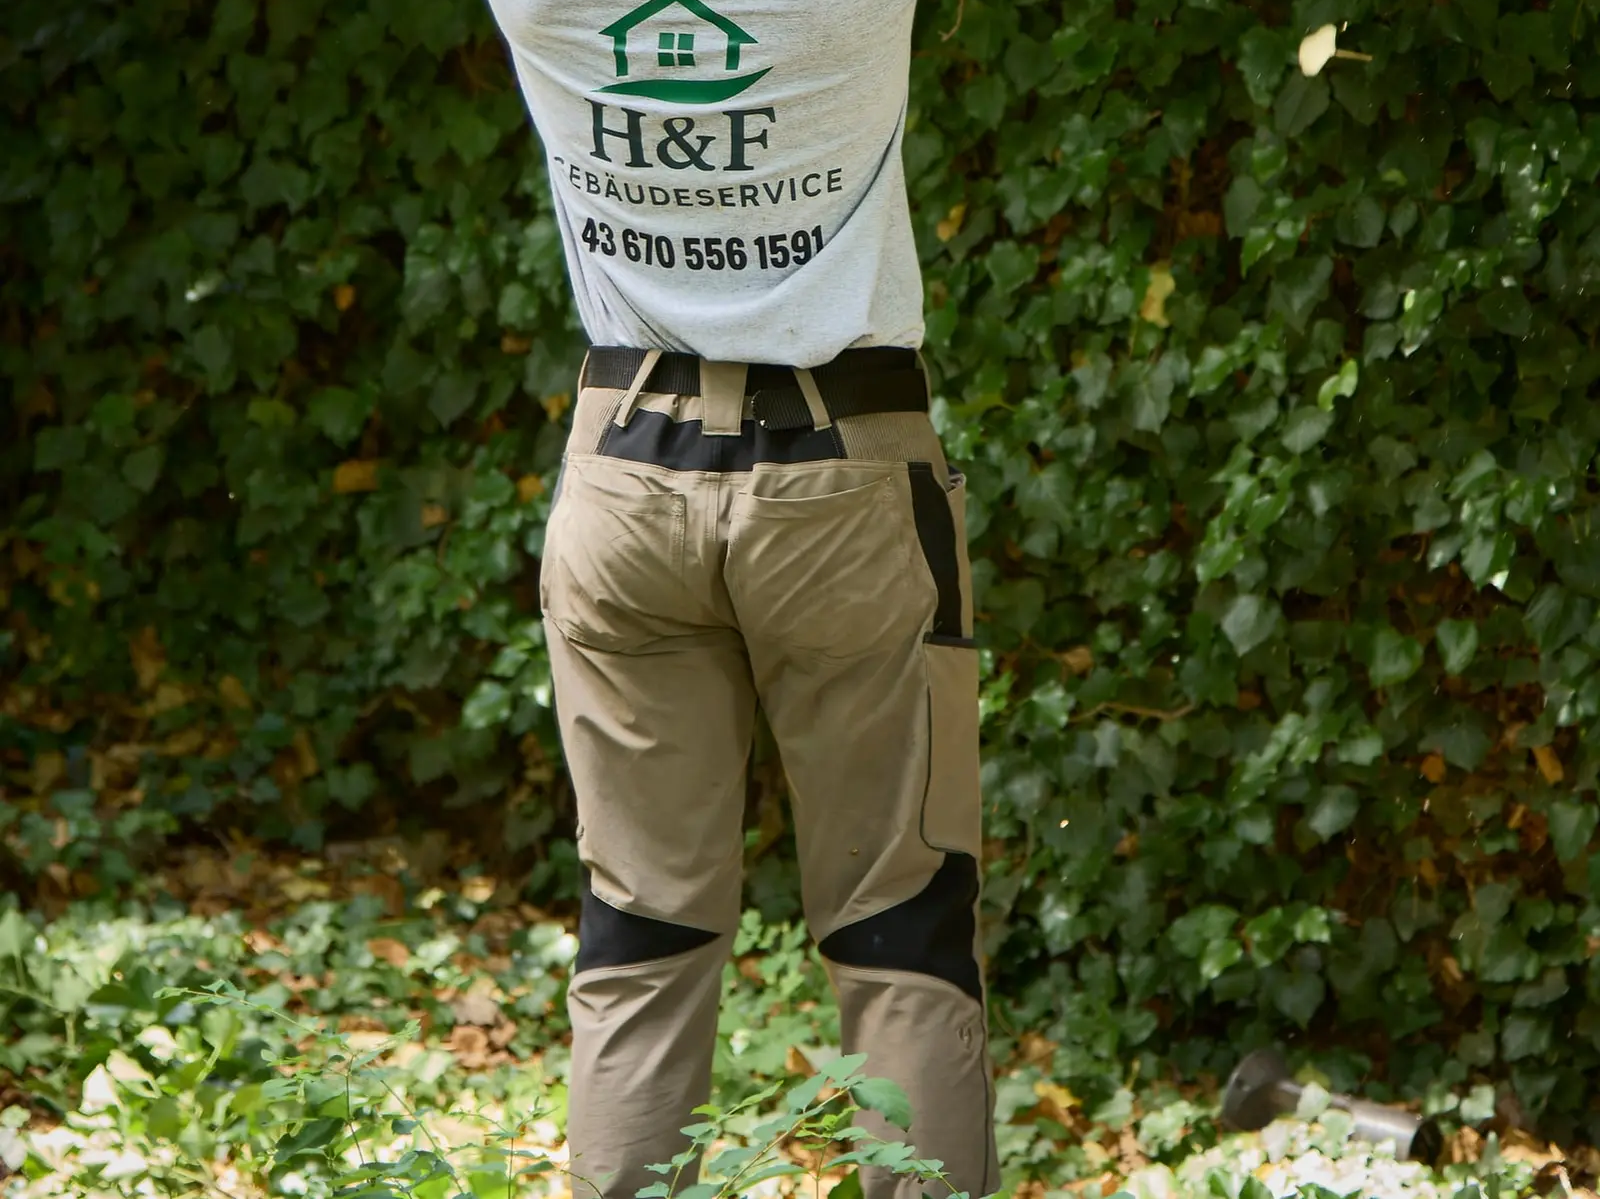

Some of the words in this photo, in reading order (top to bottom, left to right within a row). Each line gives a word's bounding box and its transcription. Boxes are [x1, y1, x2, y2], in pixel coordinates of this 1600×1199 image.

[584, 97, 777, 172] H&F
[581, 216, 617, 258] 43
[621, 224, 676, 270] 670
[682, 236, 748, 271] 556
[753, 224, 825, 271] 1591
